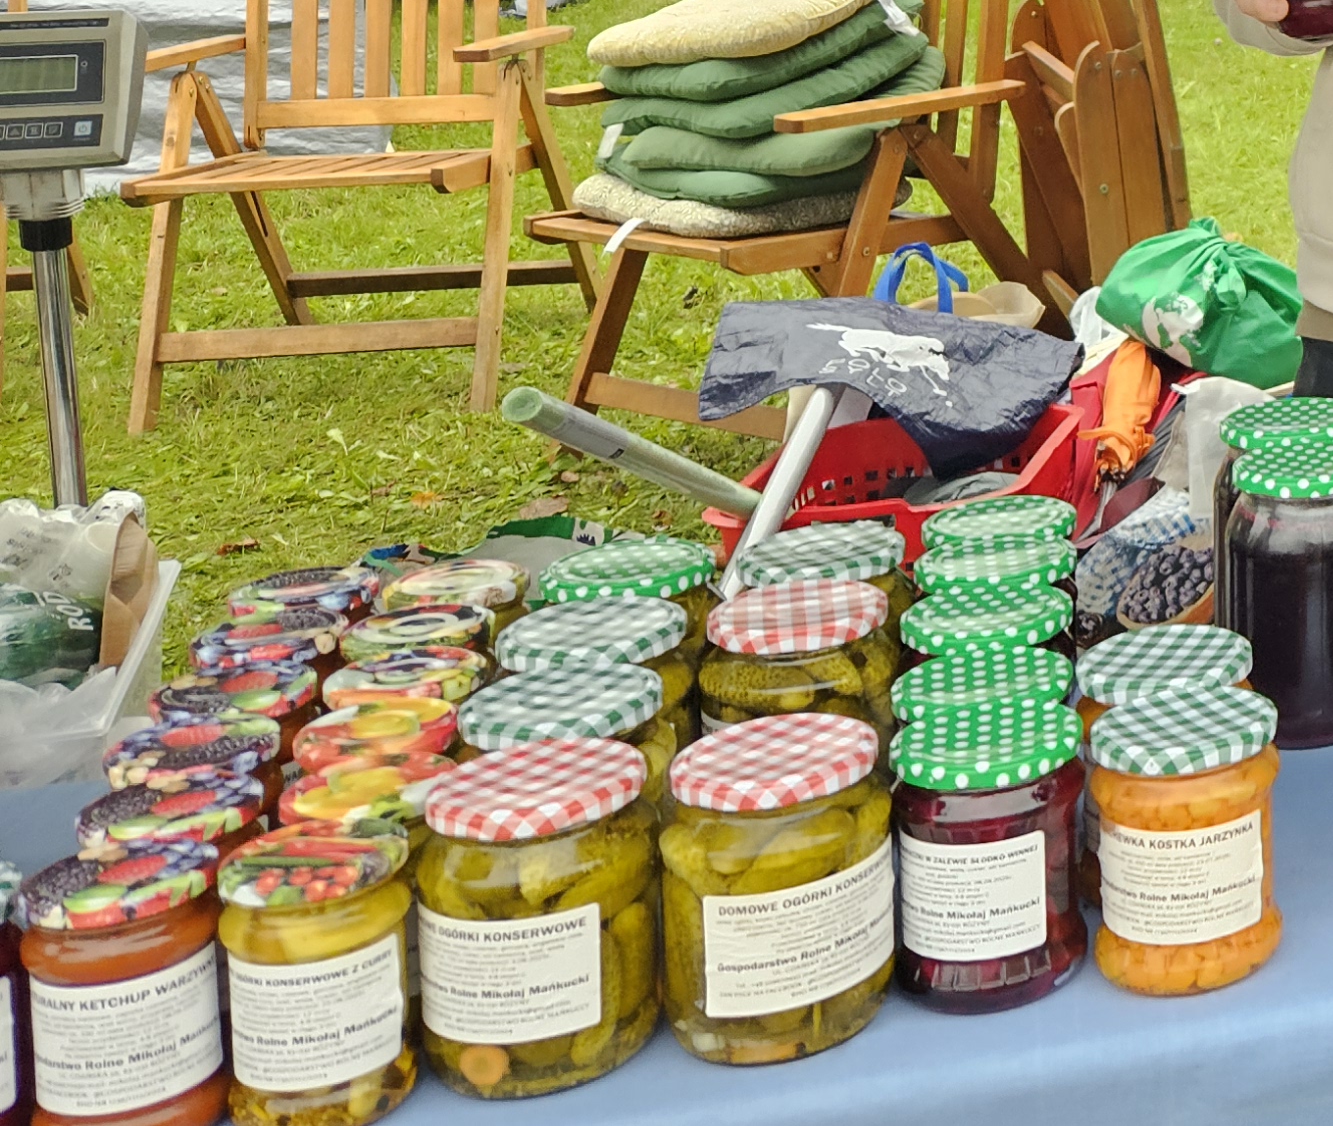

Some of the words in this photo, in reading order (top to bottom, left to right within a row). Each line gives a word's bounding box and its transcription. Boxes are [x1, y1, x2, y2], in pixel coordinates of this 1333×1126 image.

[1150, 839, 1196, 850] KOSTKA
[1199, 821, 1253, 847] JARZYNKA
[933, 856, 968, 865] ZALEWIE
[718, 901, 778, 917] DOMOWE
[782, 887, 833, 910] OGÓRKI
[946, 910, 986, 920] Mikołaj
[989, 895, 1040, 918] Mańkucki
[1139, 891, 1167, 902] Rolne
[1170, 890, 1209, 902] Mikołaj
[438, 926, 479, 942] OGÓRKI
[483, 916, 587, 942] KONSERWOWE
[265, 968, 349, 987] KONSERWOWE
[352, 964, 359, 974] Z
[361, 948, 392, 971] CURRY
[717, 955, 797, 974] Gospodarstwo
[800, 944, 831, 961] Rolne
[79, 988, 151, 1012] KETCHUP
[450, 987, 478, 999] Rolne
[481, 988, 526, 999] Mikołaj
[529, 974, 590, 996] Mańkucki
[257, 1036, 288, 1047] Rolne
[292, 1031, 340, 1046] Mikołaj
[344, 1004, 397, 1036] Mańkucki
[85, 1057, 125, 1070] Rolne
[127, 1041, 176, 1064] Mikołaj
